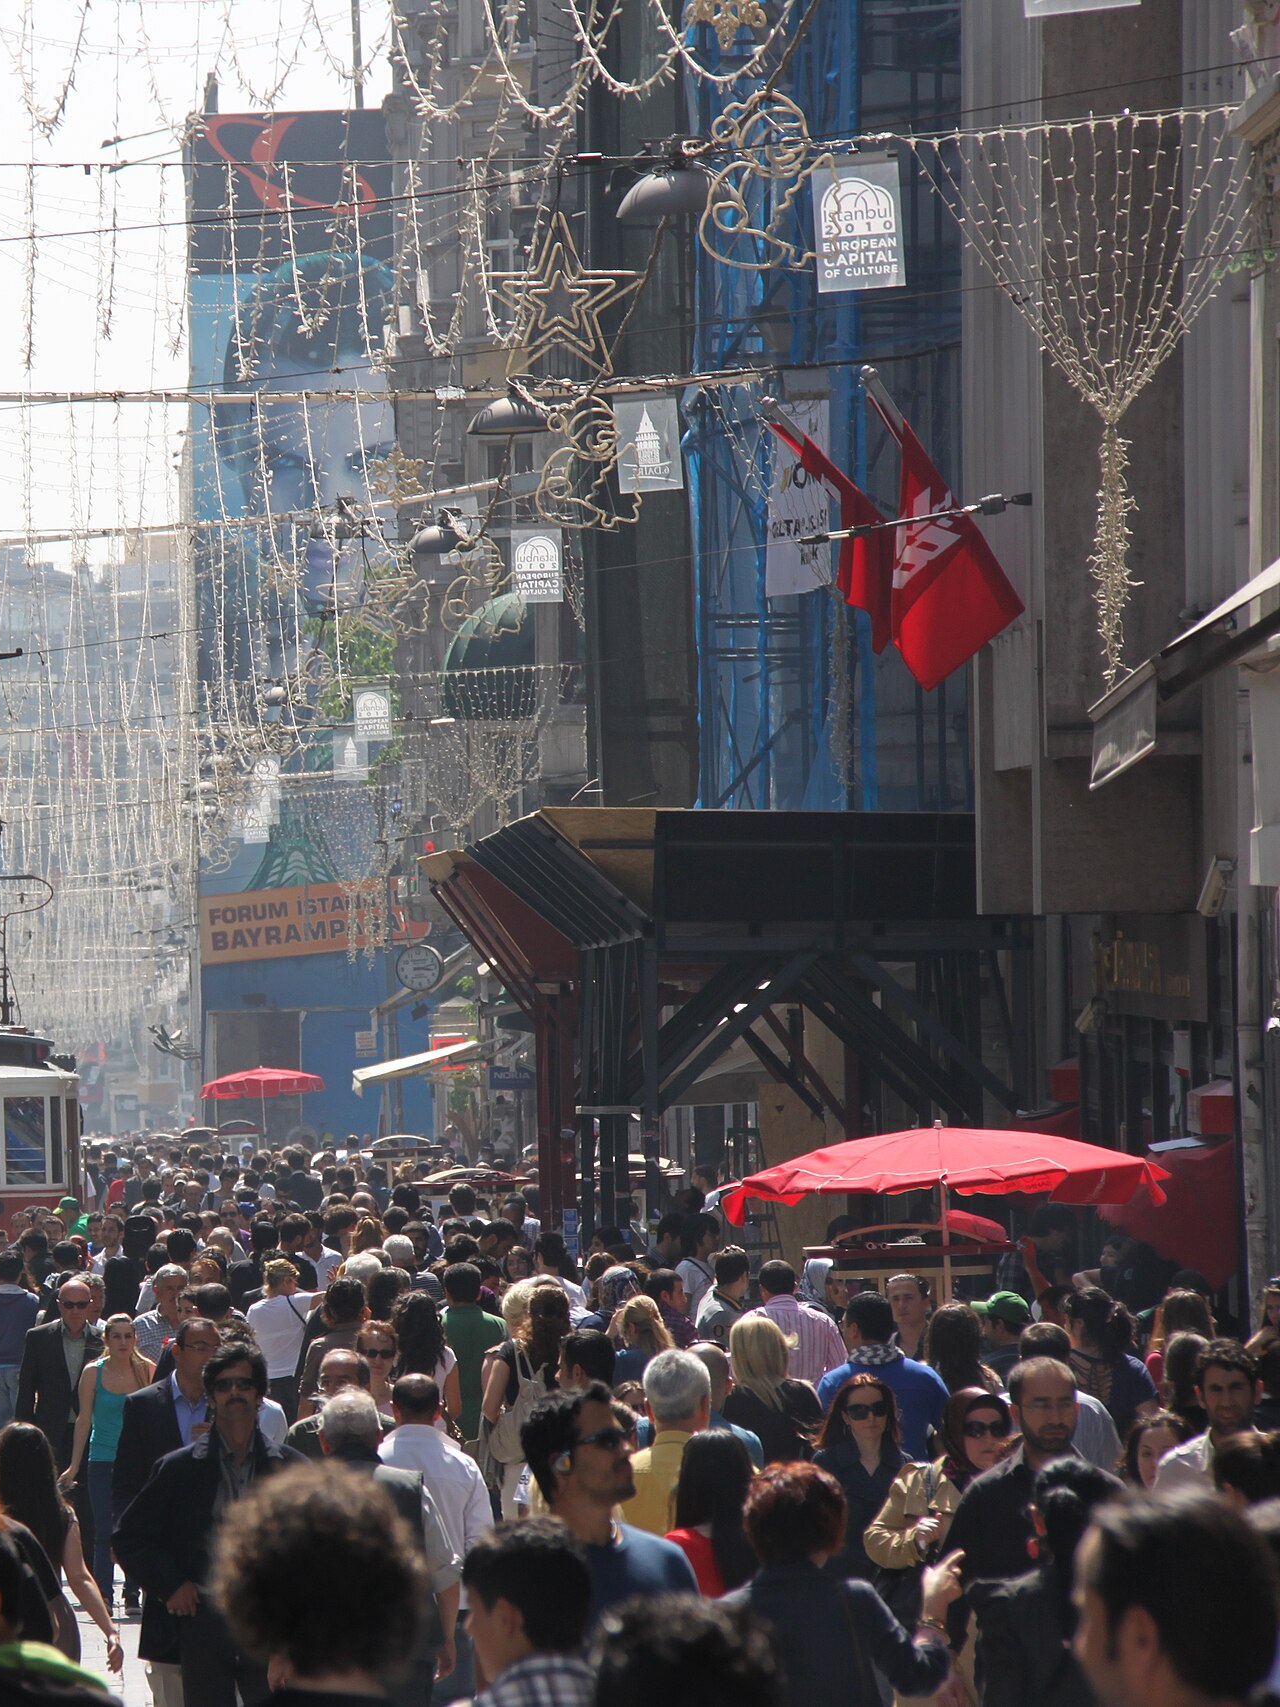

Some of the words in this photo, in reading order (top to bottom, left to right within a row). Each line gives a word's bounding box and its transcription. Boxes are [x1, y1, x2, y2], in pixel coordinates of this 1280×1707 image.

[822, 237, 897, 252] EUROPEAN
[824, 269, 841, 279] OF
[845, 264, 899, 277] CULTURE
[209, 901, 288, 926] FORUM
[493, 1070, 530, 1080] NOKIA
